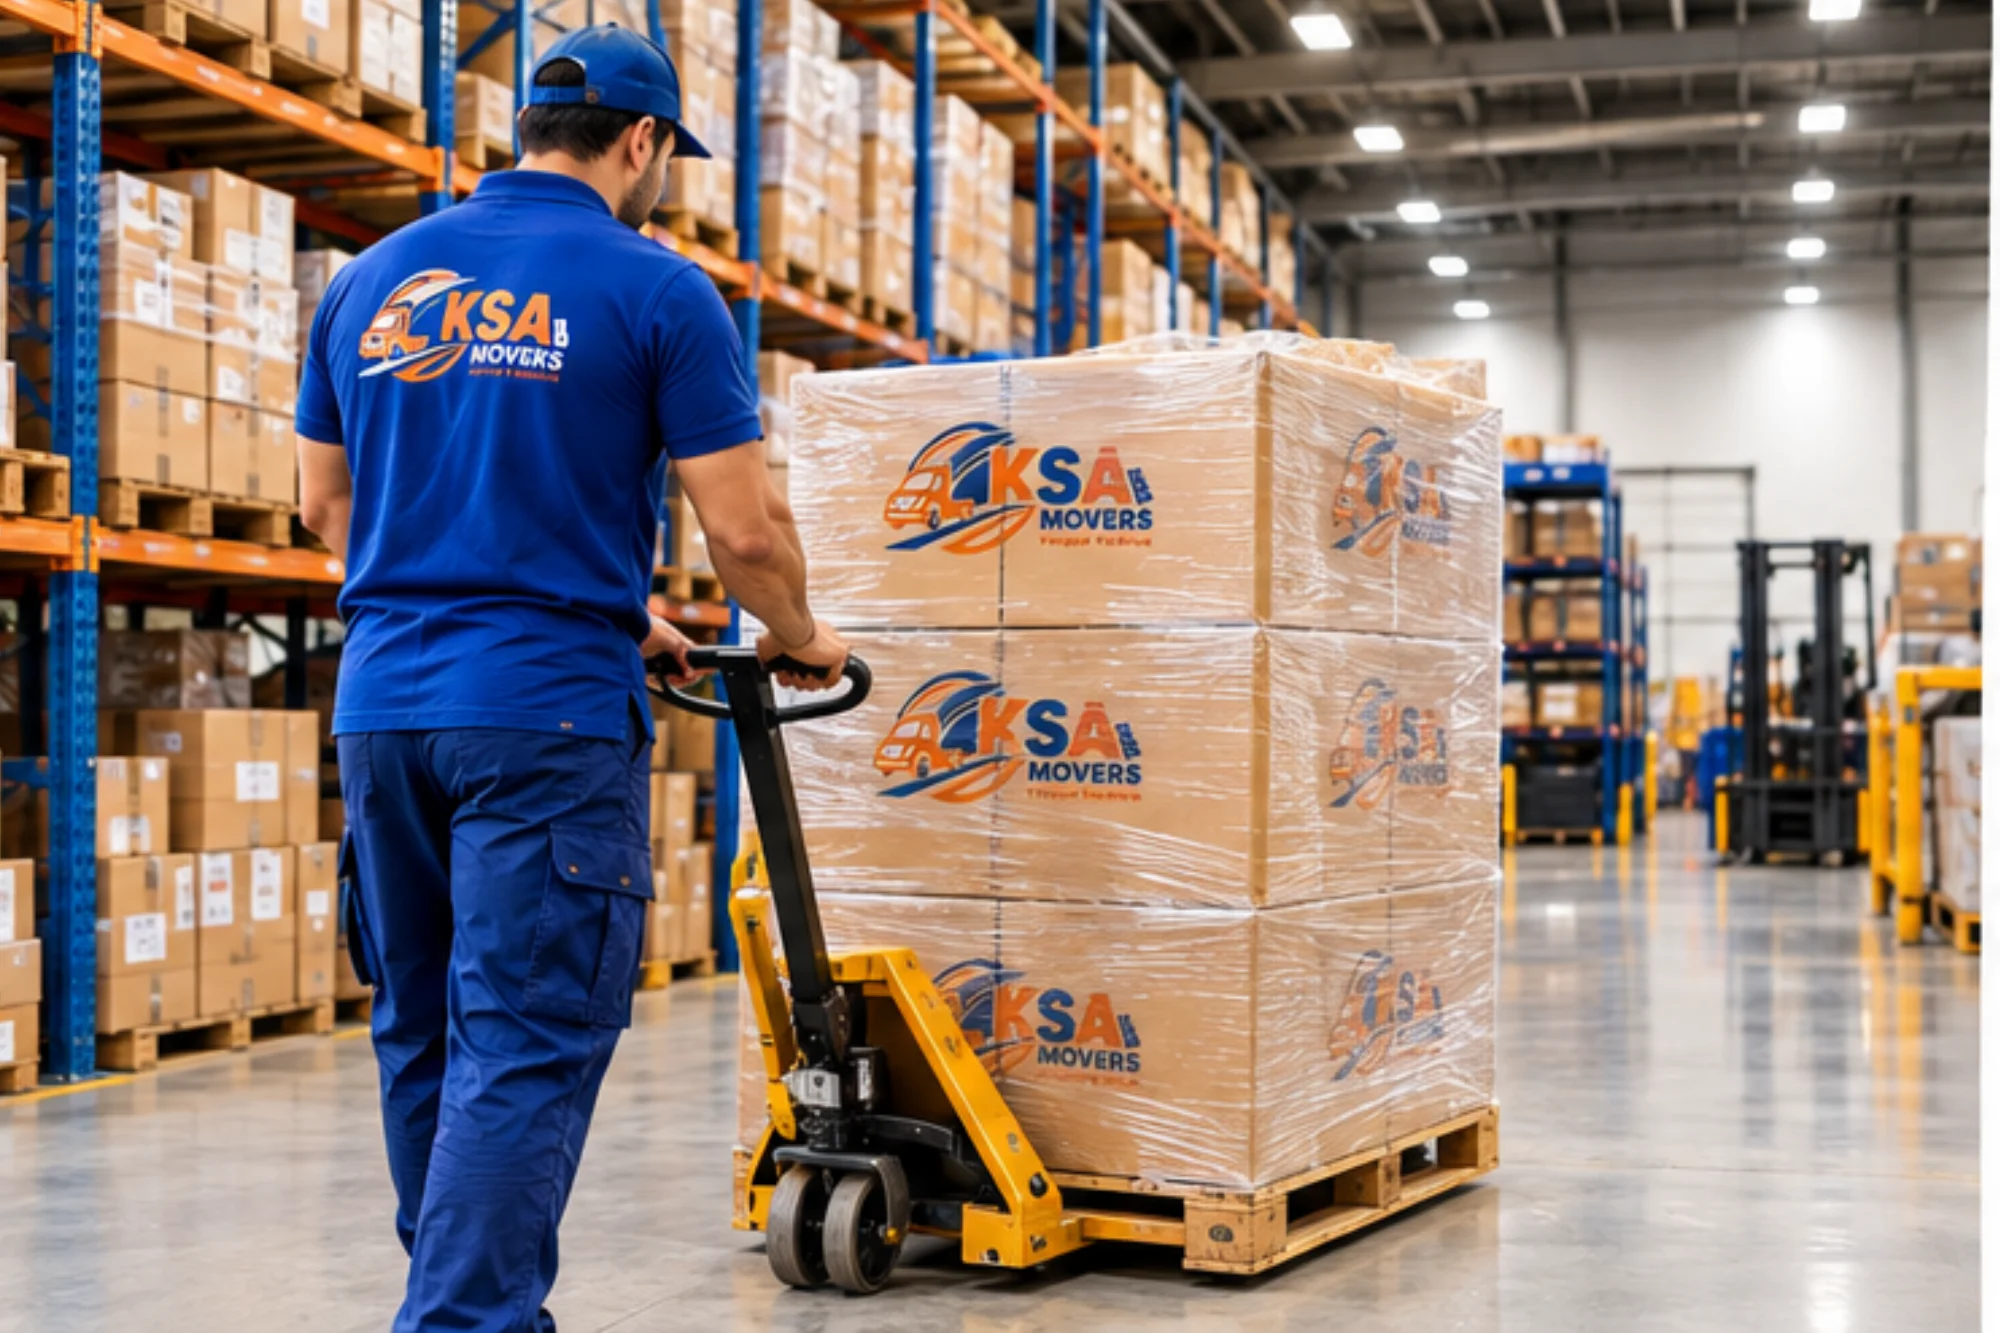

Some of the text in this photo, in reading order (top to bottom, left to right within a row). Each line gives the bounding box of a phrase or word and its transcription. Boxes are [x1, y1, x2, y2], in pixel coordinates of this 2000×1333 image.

[440, 289, 550, 345] KSA
[990, 446, 1132, 505] KSA
[1040, 508, 1153, 531] MOVERS
[980, 696, 1121, 758] KSA
[1028, 761, 1142, 784] MOVERS
[995, 983, 1122, 1048] KSA
[1038, 1046, 1141, 1072] MOVERS
